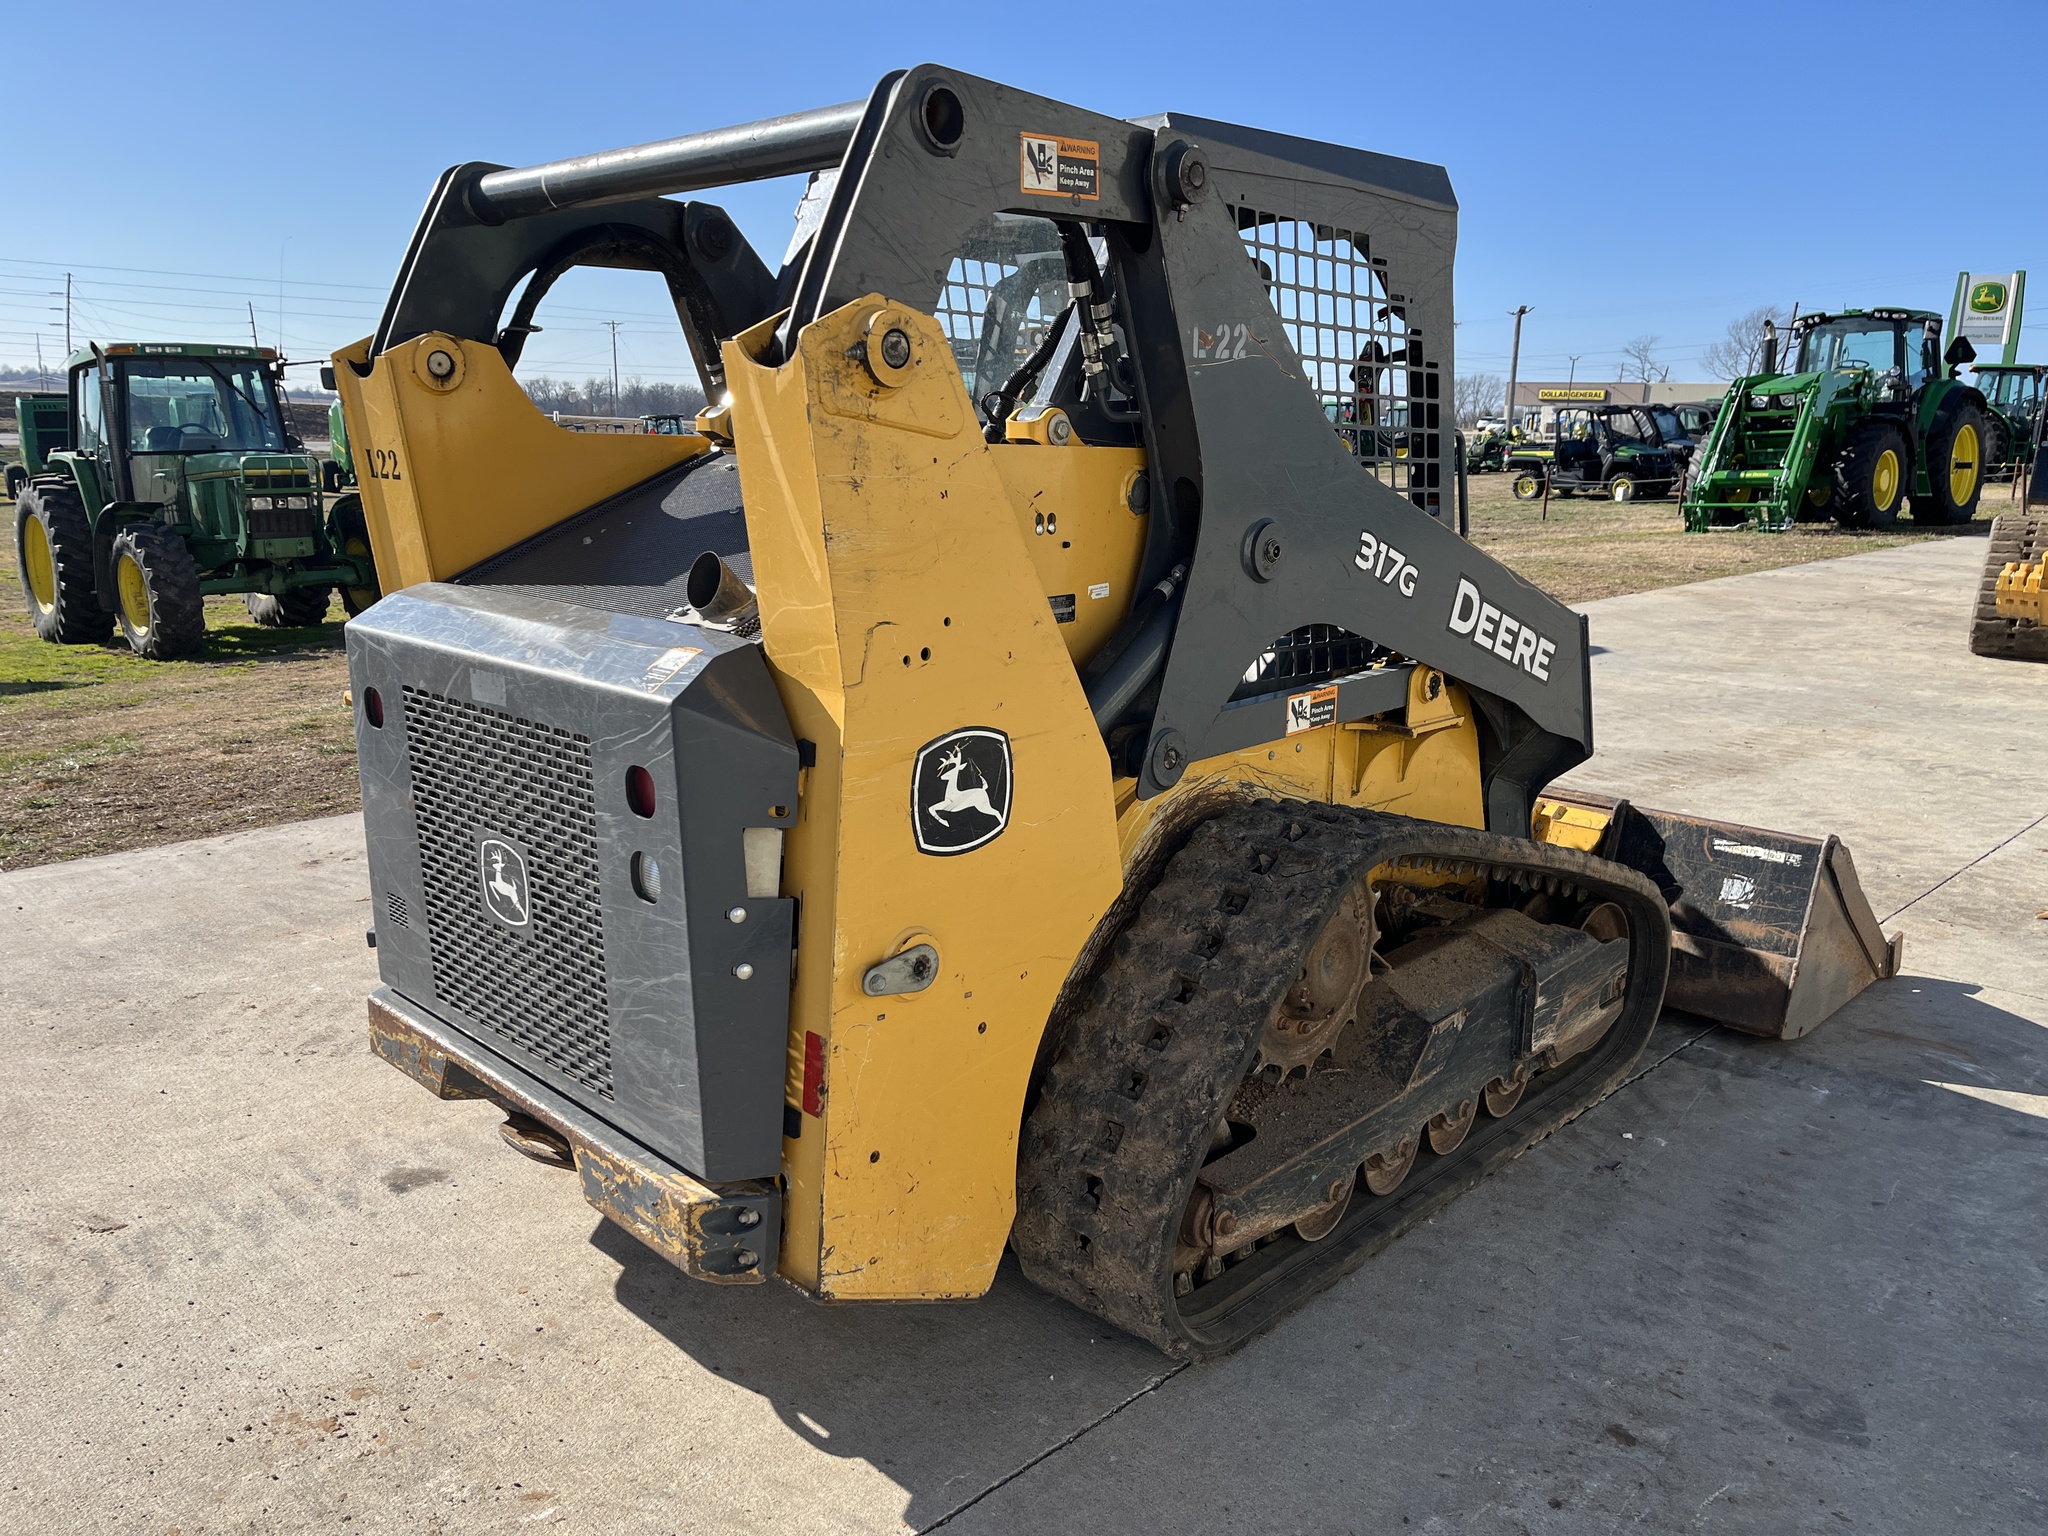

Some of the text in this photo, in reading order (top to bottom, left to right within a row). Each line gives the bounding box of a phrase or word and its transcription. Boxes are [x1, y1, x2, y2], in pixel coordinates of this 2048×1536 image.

[1067, 144, 1096, 155] WARNING
[1060, 164, 1094, 176] Pinch Area
[1060, 177, 1090, 189] Keep Away
[1541, 390, 1568, 398] DOLLAR
[365, 448, 402, 480] L22
[1354, 531, 1419, 598] 317G
[1448, 577, 1557, 682] DEERE
[1311, 704, 1334, 715] Pinch Area
